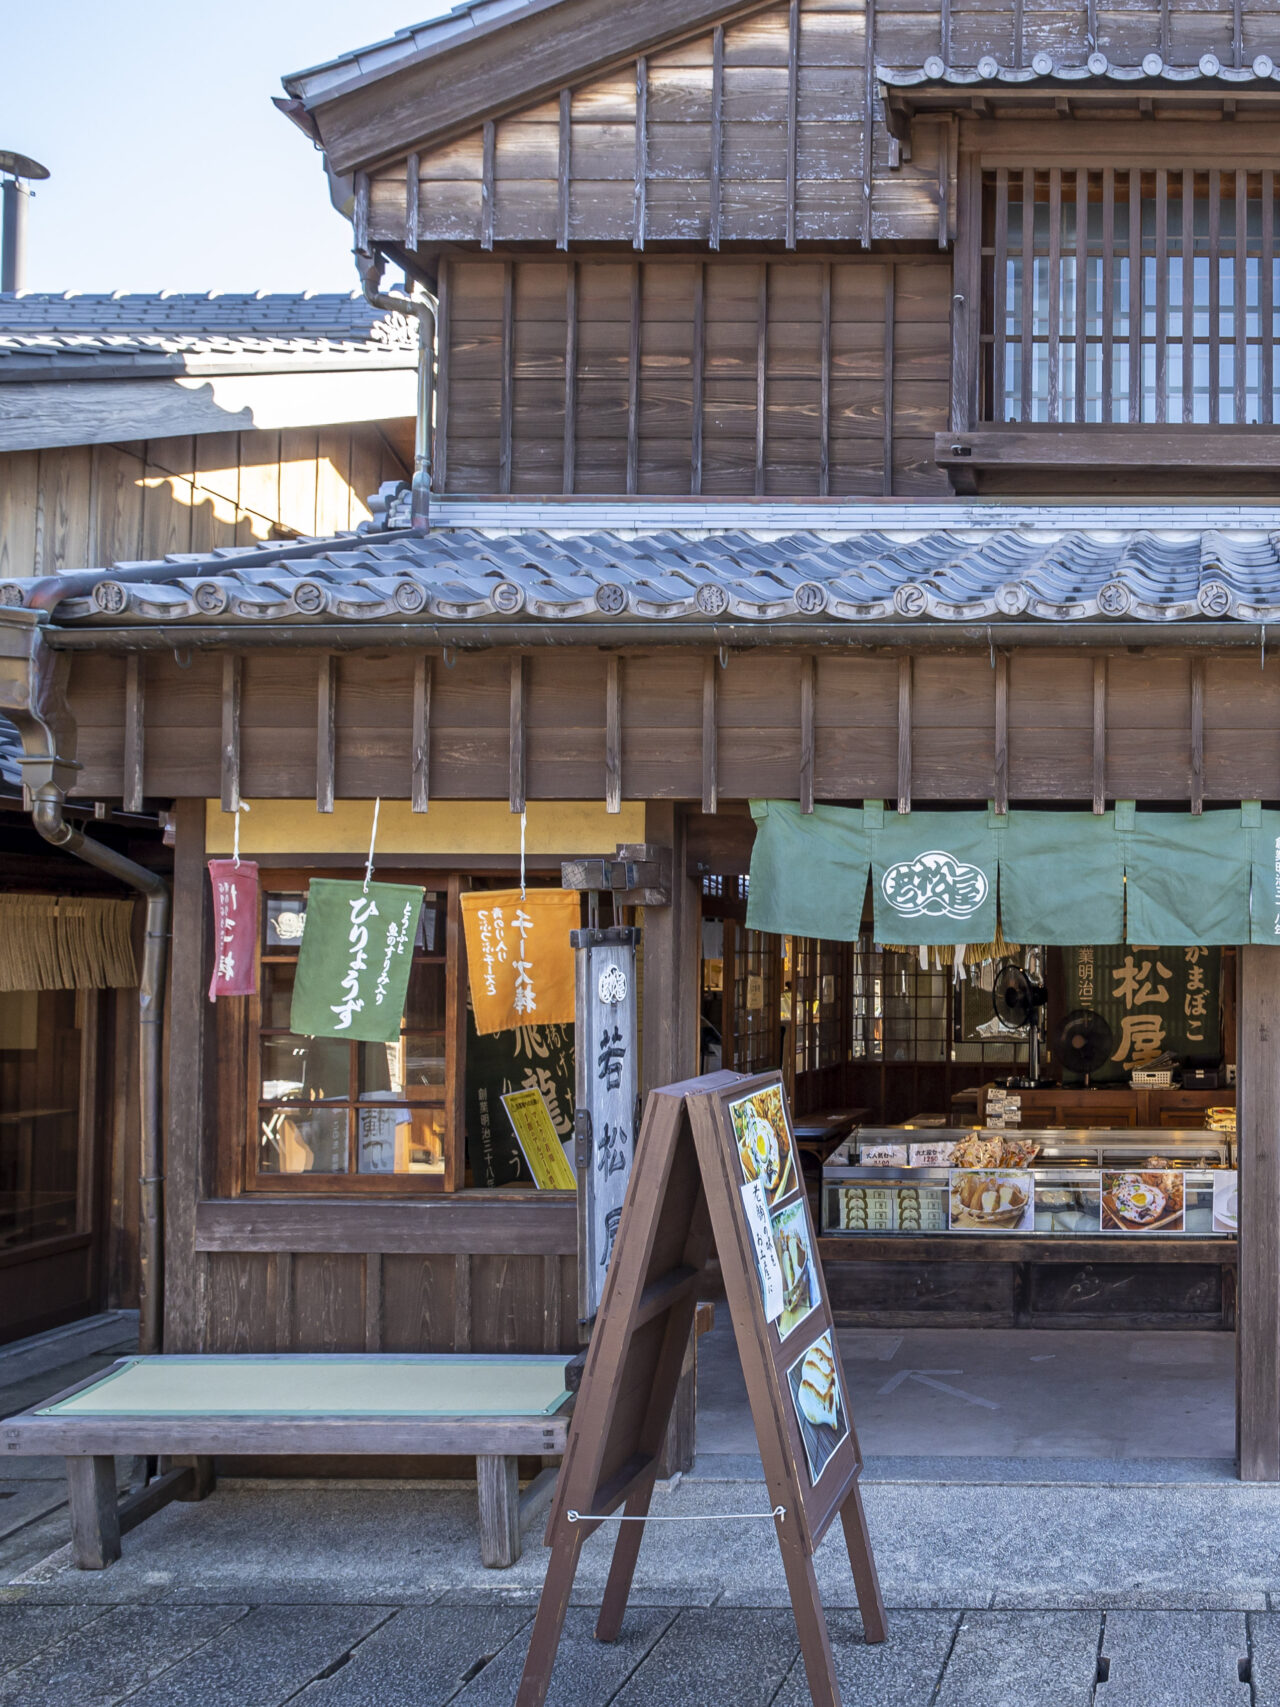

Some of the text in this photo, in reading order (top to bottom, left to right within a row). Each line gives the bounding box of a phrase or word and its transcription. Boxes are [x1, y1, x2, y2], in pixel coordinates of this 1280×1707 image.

[330, 897, 379, 1030] ひりょうず
[374, 922, 398, 1005] 魚のすりみ入り
[397, 901, 413, 955] とうふと
[1111, 946, 1173, 1070] 松屋
[1184, 946, 1210, 1041] かまぼこ
